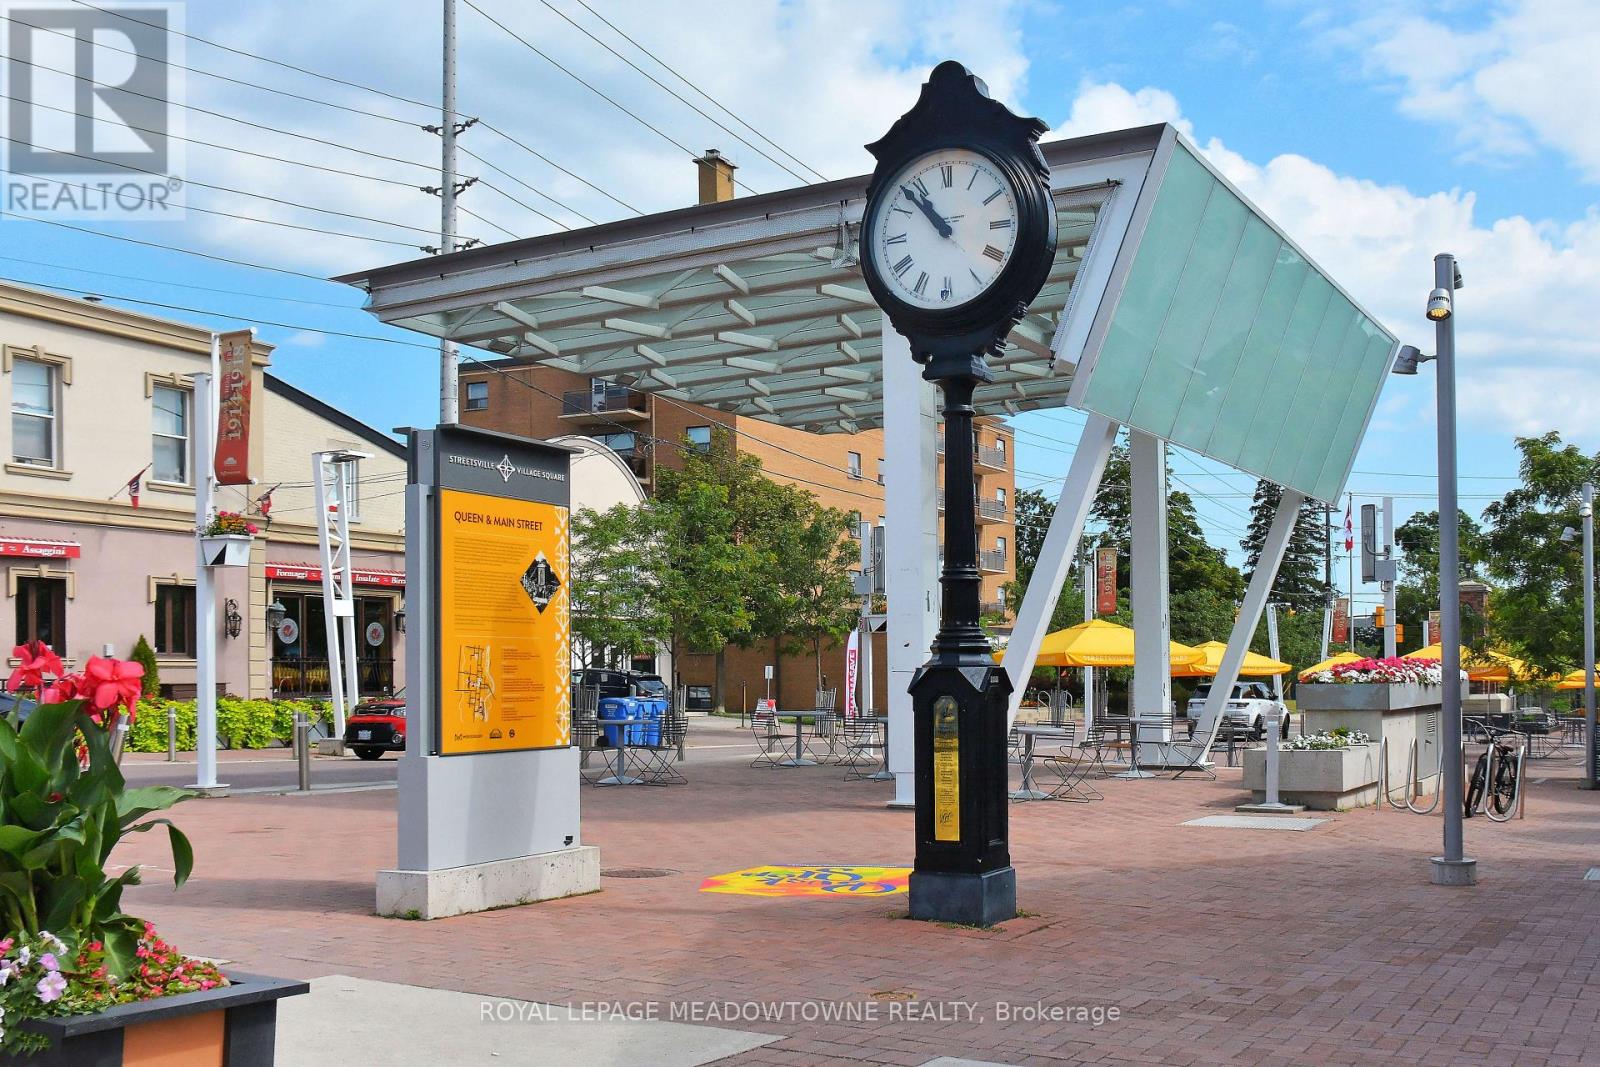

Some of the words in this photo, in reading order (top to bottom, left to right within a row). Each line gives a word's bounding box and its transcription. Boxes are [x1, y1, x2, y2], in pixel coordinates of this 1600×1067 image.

[940, 165, 953, 189] XII
[983, 189, 1002, 206] II
[989, 219, 1011, 230] III
[983, 244, 1004, 262] IIII
[892, 254, 915, 279] VIII
[913, 271, 930, 296] VII
[228, 343, 245, 441] 1914-1918
[449, 456, 495, 469] STREETSVILLE
[516, 467, 541, 477] VILLAGE
[541, 471, 566, 482] SQUARE
[454, 511, 484, 524] QUEEN
[486, 515, 492, 525] &
[493, 516, 515, 528] MAIN
[517, 519, 543, 531] STREET
[22, 544, 66, 557] Assaggini
